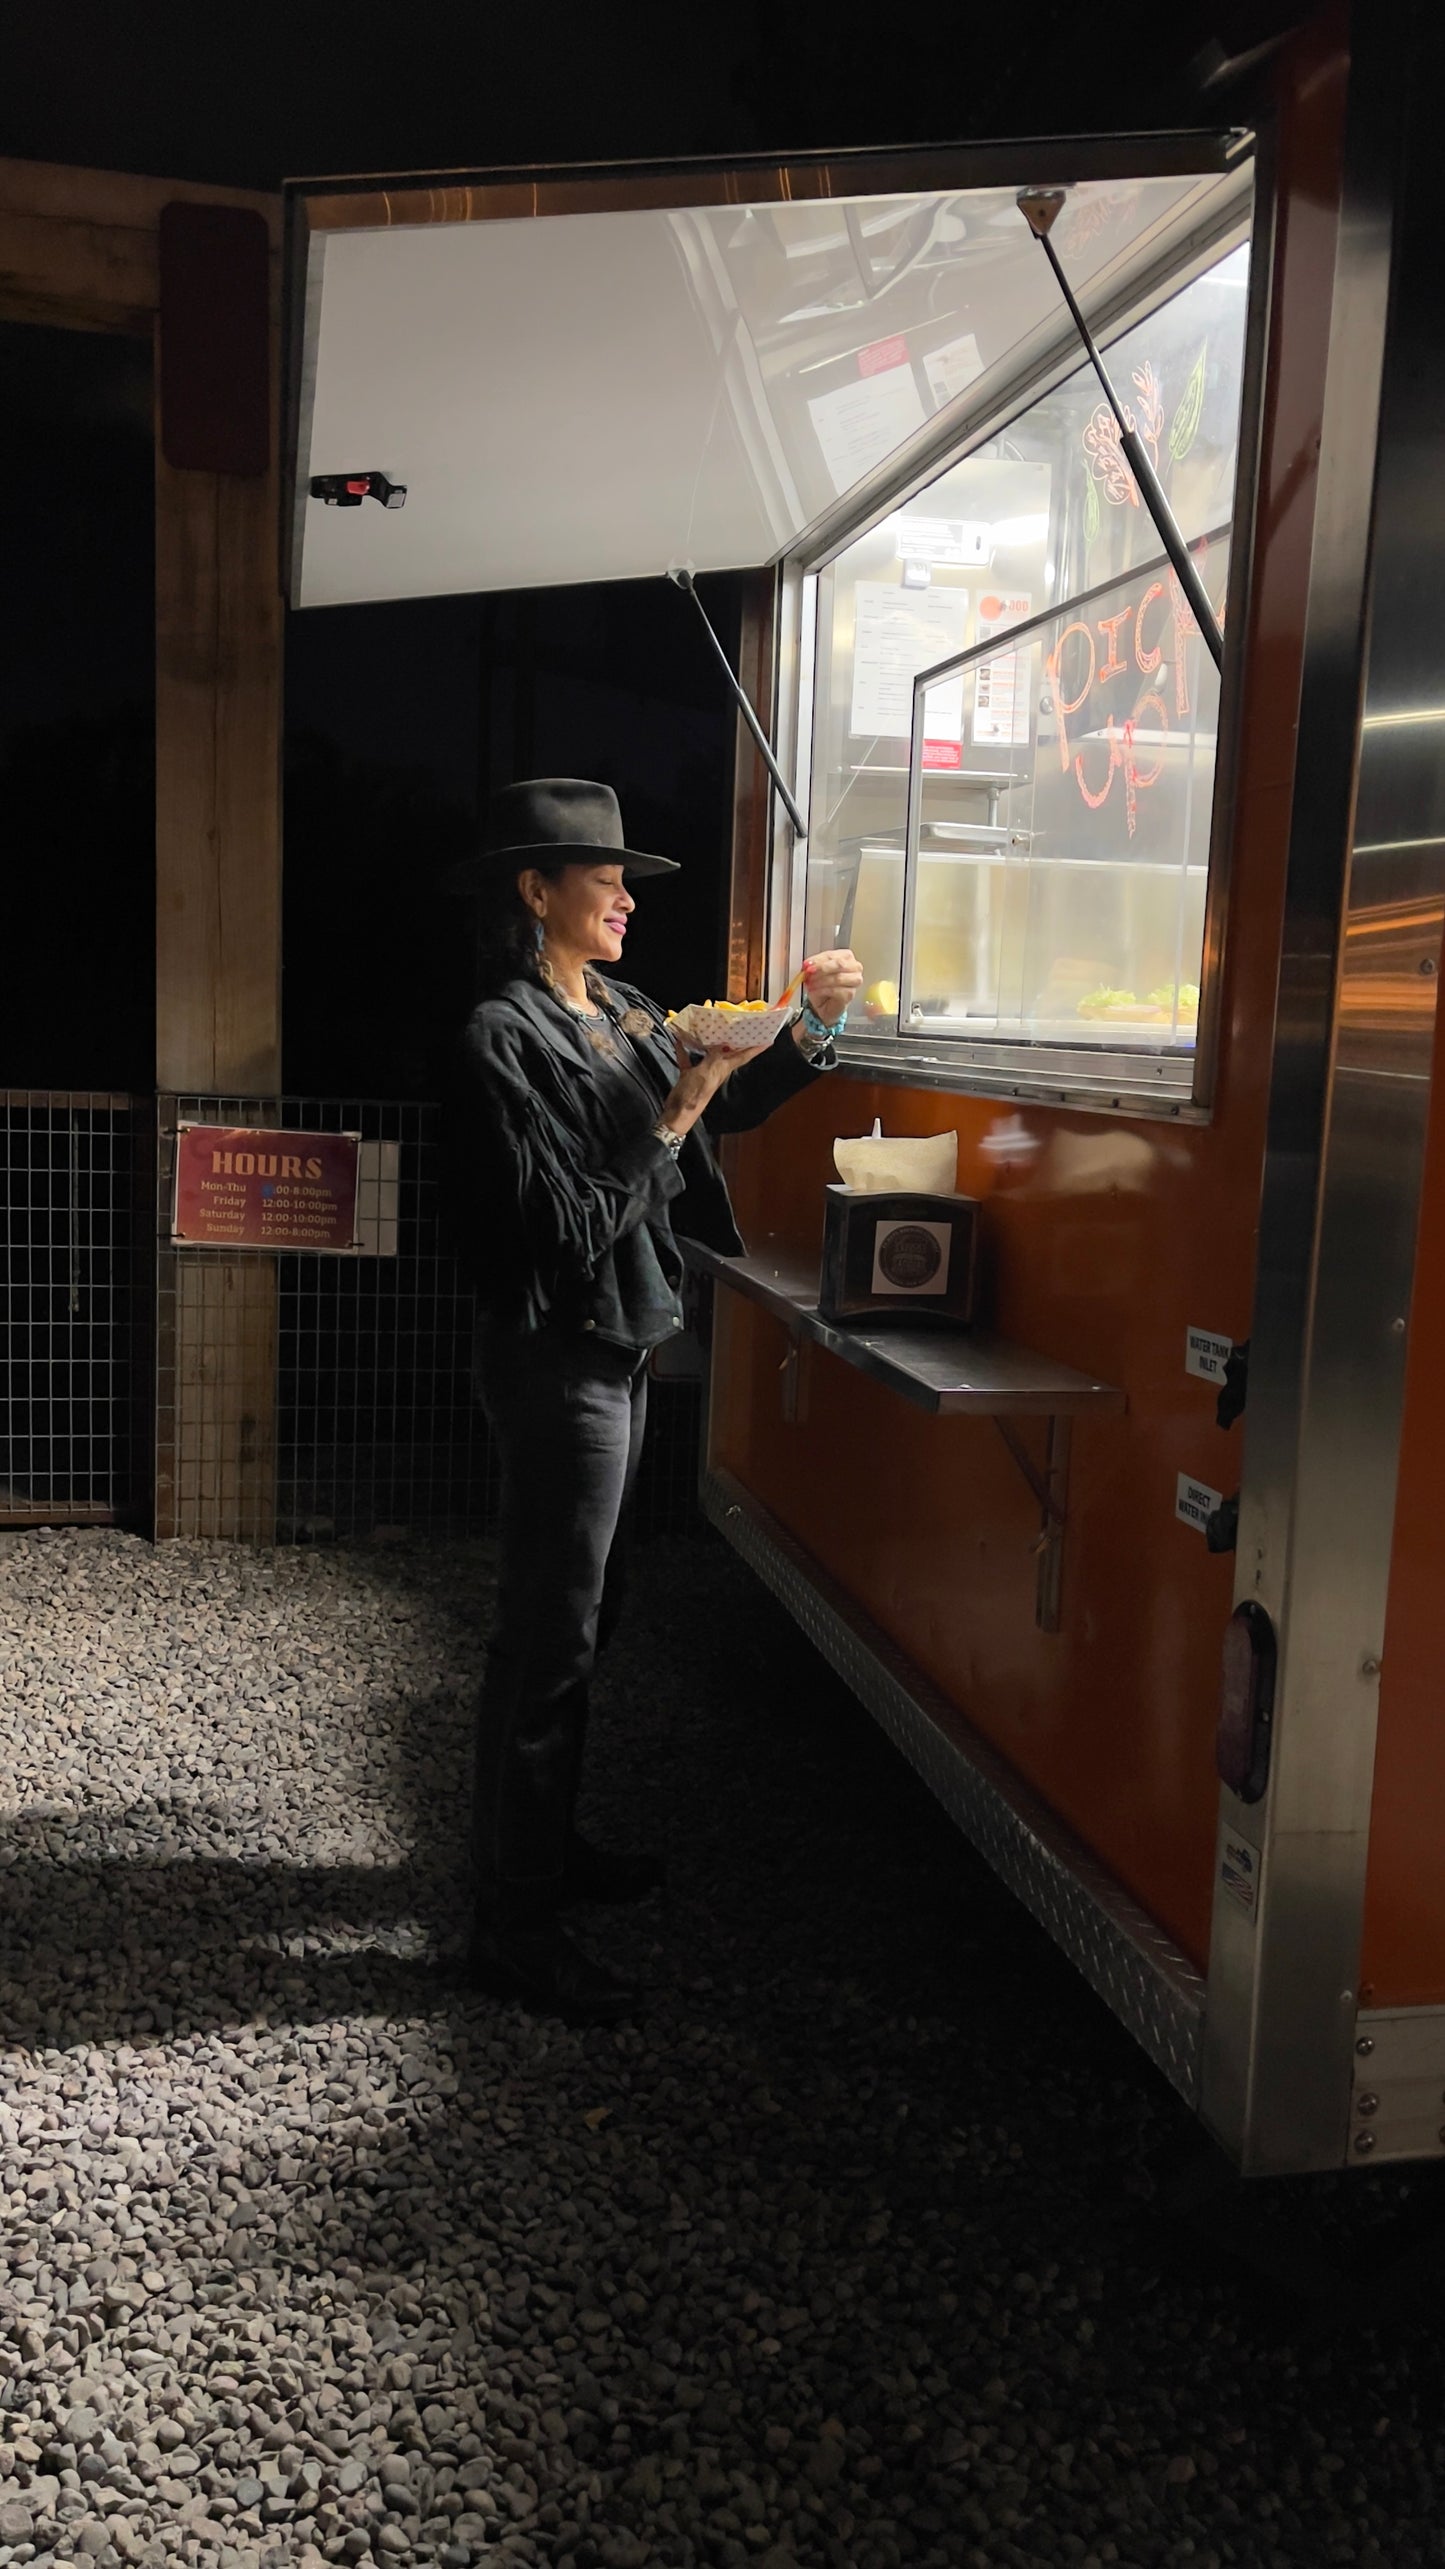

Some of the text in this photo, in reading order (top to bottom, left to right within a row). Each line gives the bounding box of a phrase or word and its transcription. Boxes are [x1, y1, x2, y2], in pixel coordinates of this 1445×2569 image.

[212, 1151, 322, 1180] HOURS
[201, 1181, 332, 1198] Mon-Thu :00-8:00pm
[213, 1196, 246, 1209] Friday
[199, 1208, 246, 1222] Saturday
[206, 1223, 245, 1236] Sunday
[1190, 1335, 1229, 1358] WATER TANK
[1199, 1355, 1217, 1374] INLET
[1188, 1486, 1211, 1510] DIRECT
[1178, 1499, 1199, 1521] WATER
